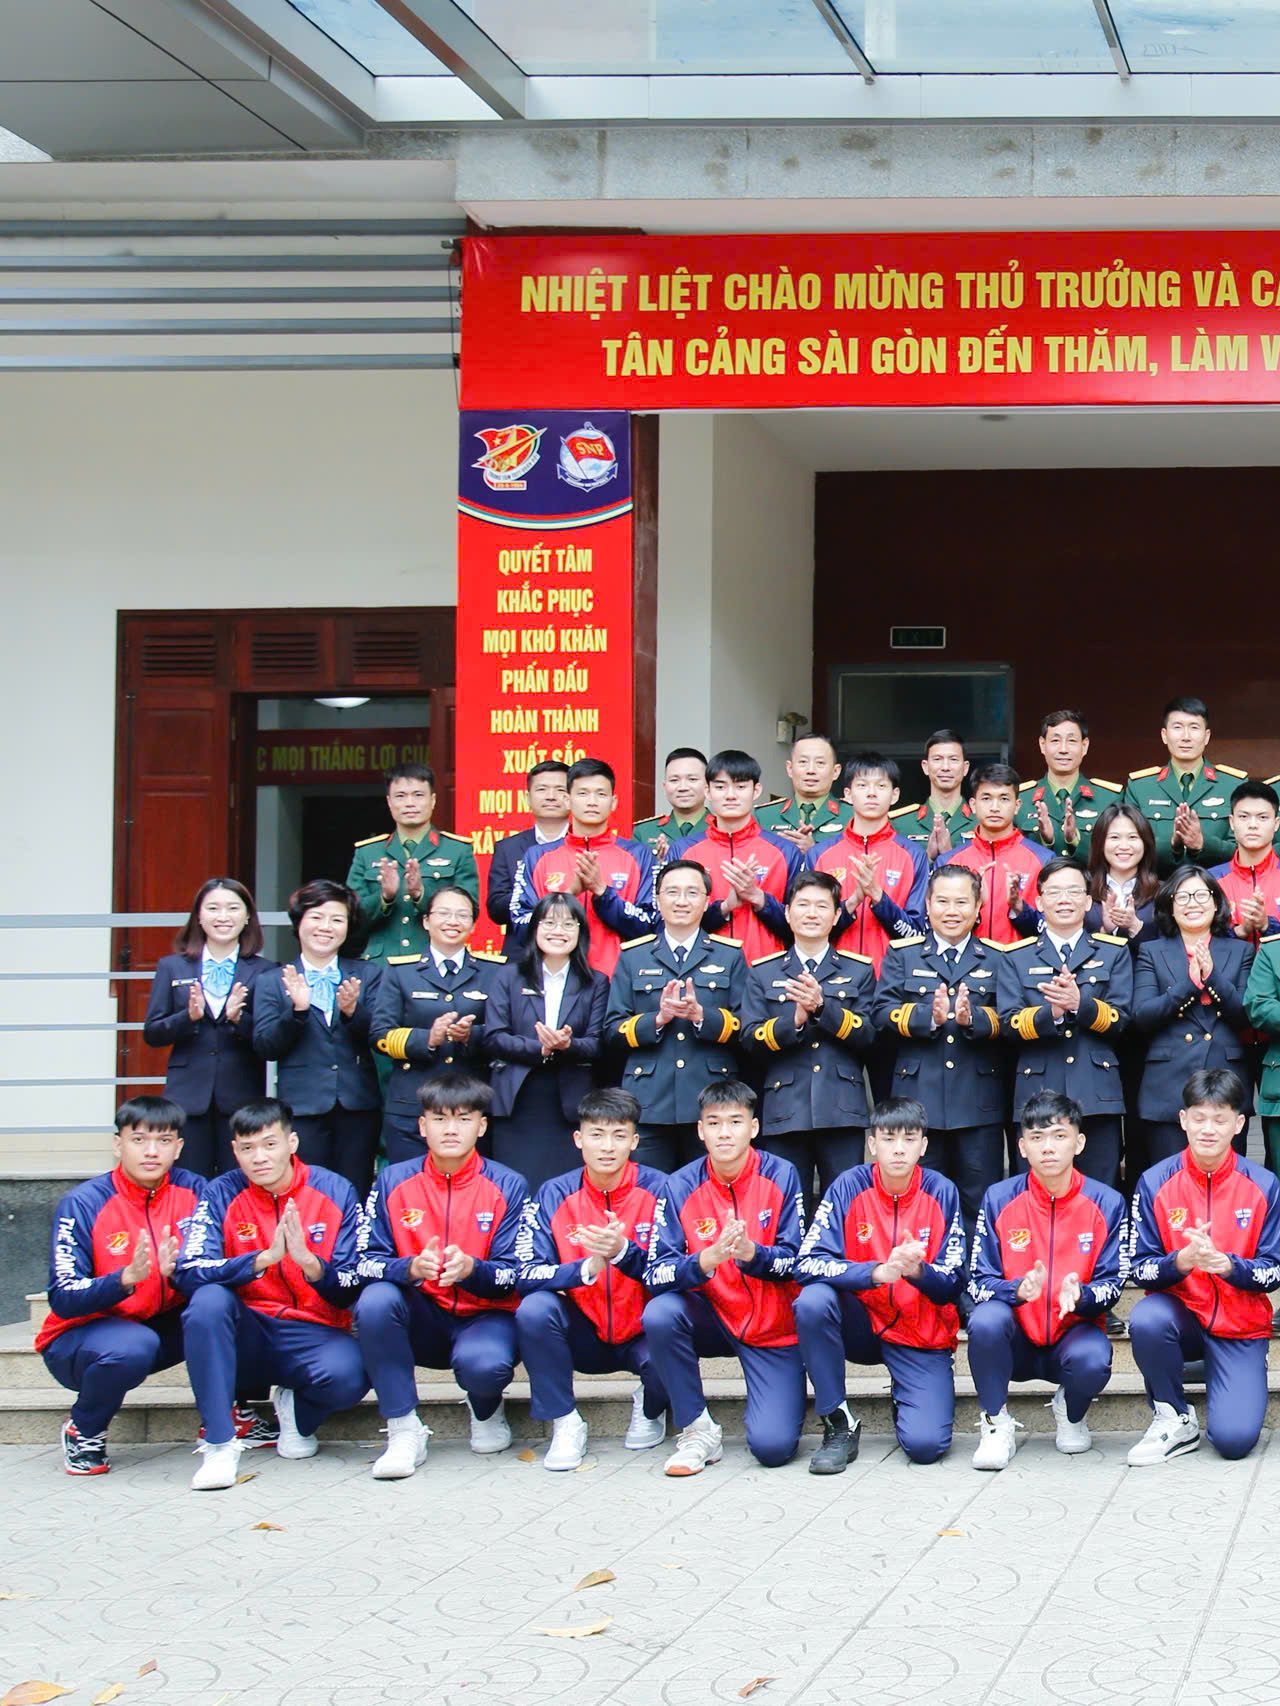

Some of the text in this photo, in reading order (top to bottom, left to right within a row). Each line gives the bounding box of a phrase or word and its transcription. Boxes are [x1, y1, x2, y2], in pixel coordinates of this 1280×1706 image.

[521, 267, 627, 320] NHIỆT
[639, 267, 712, 319] LIỆT
[725, 266, 821, 310] CHÀO
[835, 265, 943, 309] MỪNG
[956, 260, 1023, 308] THỦ
[1036, 259, 1180, 308] TRƯỞNG
[1193, 263, 1239, 306] VÀ
[602, 333, 672, 376] TÂN
[685, 326, 785, 375] CẢNG
[798, 330, 858, 374] SÀI
[872, 328, 946, 374] GÒN
[958, 325, 1032, 373] ĐẾN
[1044, 328, 1158, 377] THĂM,
[1171, 328, 1249, 371] LÀM
[576, 441, 604, 456] SNP
[498, 542, 592, 576] QUYẾT TÂM
[497, 581, 593, 617] KHẮC PHỤC
[483, 624, 607, 658] MỌI KHÓ KHĂN
[502, 663, 588, 692] PHẤN ĐẤU
[491, 705, 599, 733] HOÀN THÀNH
[479, 790, 512, 818] MỌI
